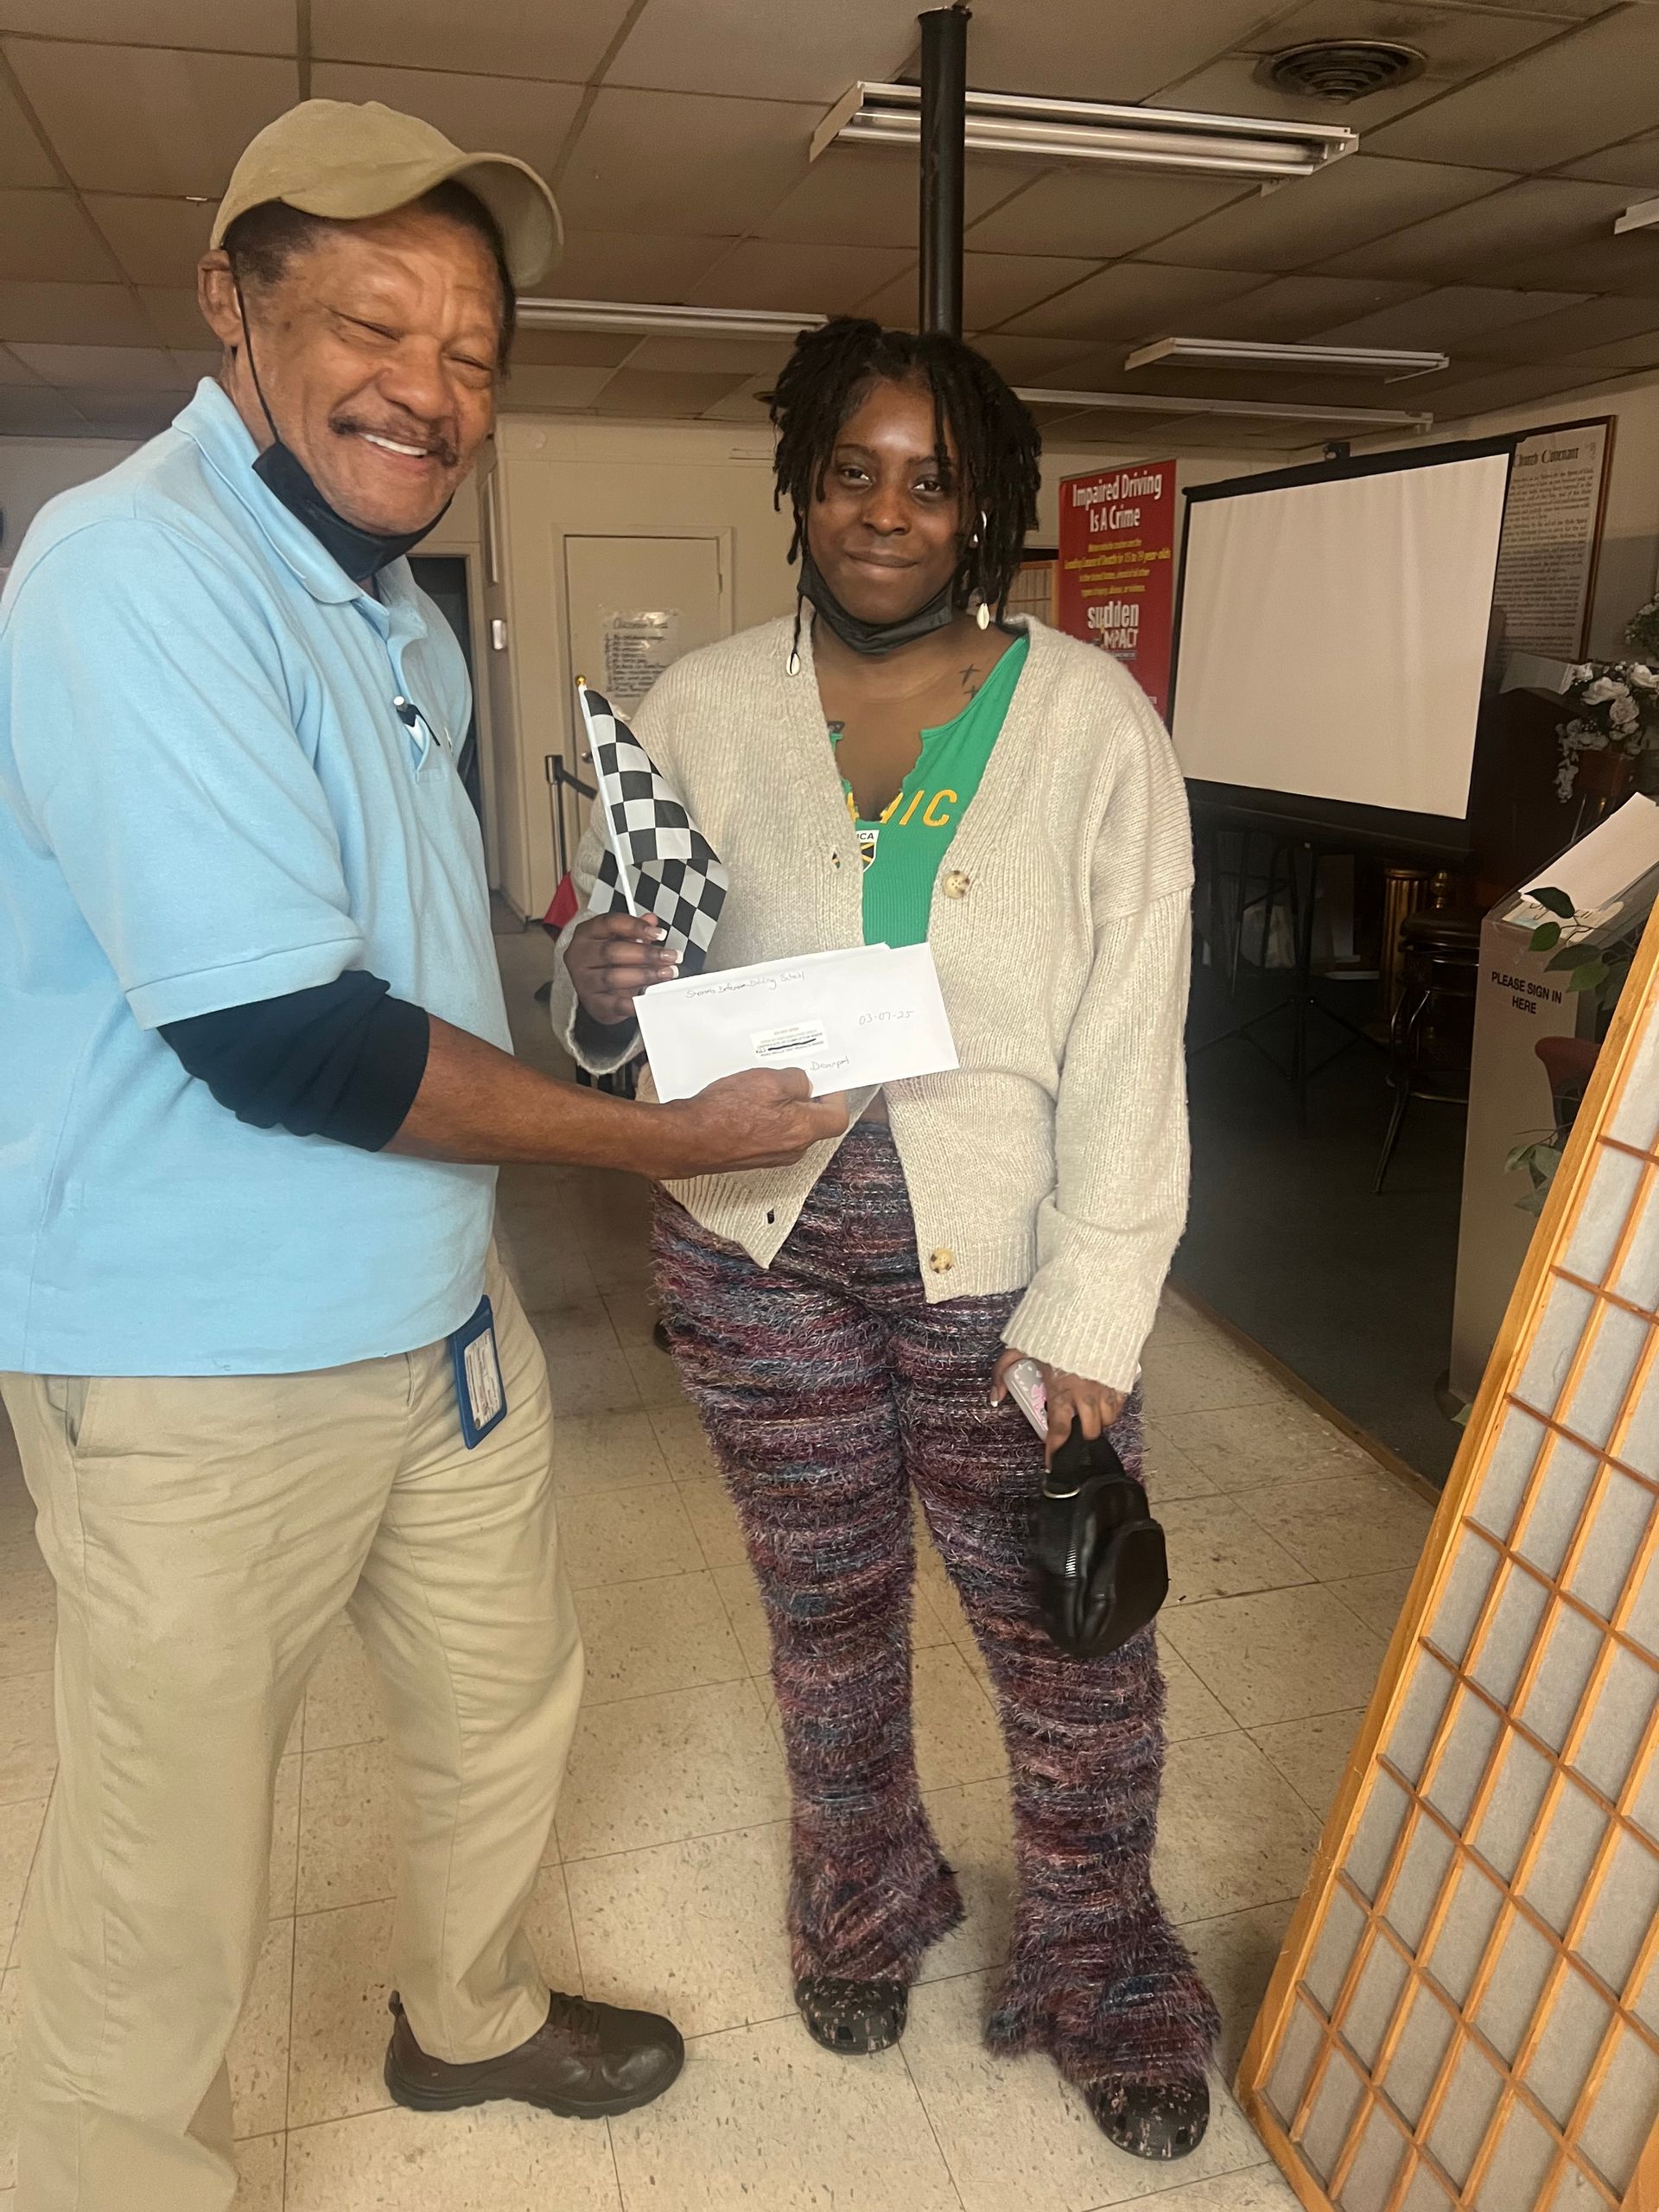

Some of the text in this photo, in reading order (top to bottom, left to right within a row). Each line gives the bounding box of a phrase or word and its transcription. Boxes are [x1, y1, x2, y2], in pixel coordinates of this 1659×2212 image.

[1072, 470, 1162, 512] Impaired Driving
[1090, 504, 1141, 533] Is A Crime
[1087, 600, 1140, 630] sudden
[1491, 970, 1562, 1005] PLEASE SIGN IN
[1511, 995, 1537, 1015] HERE
